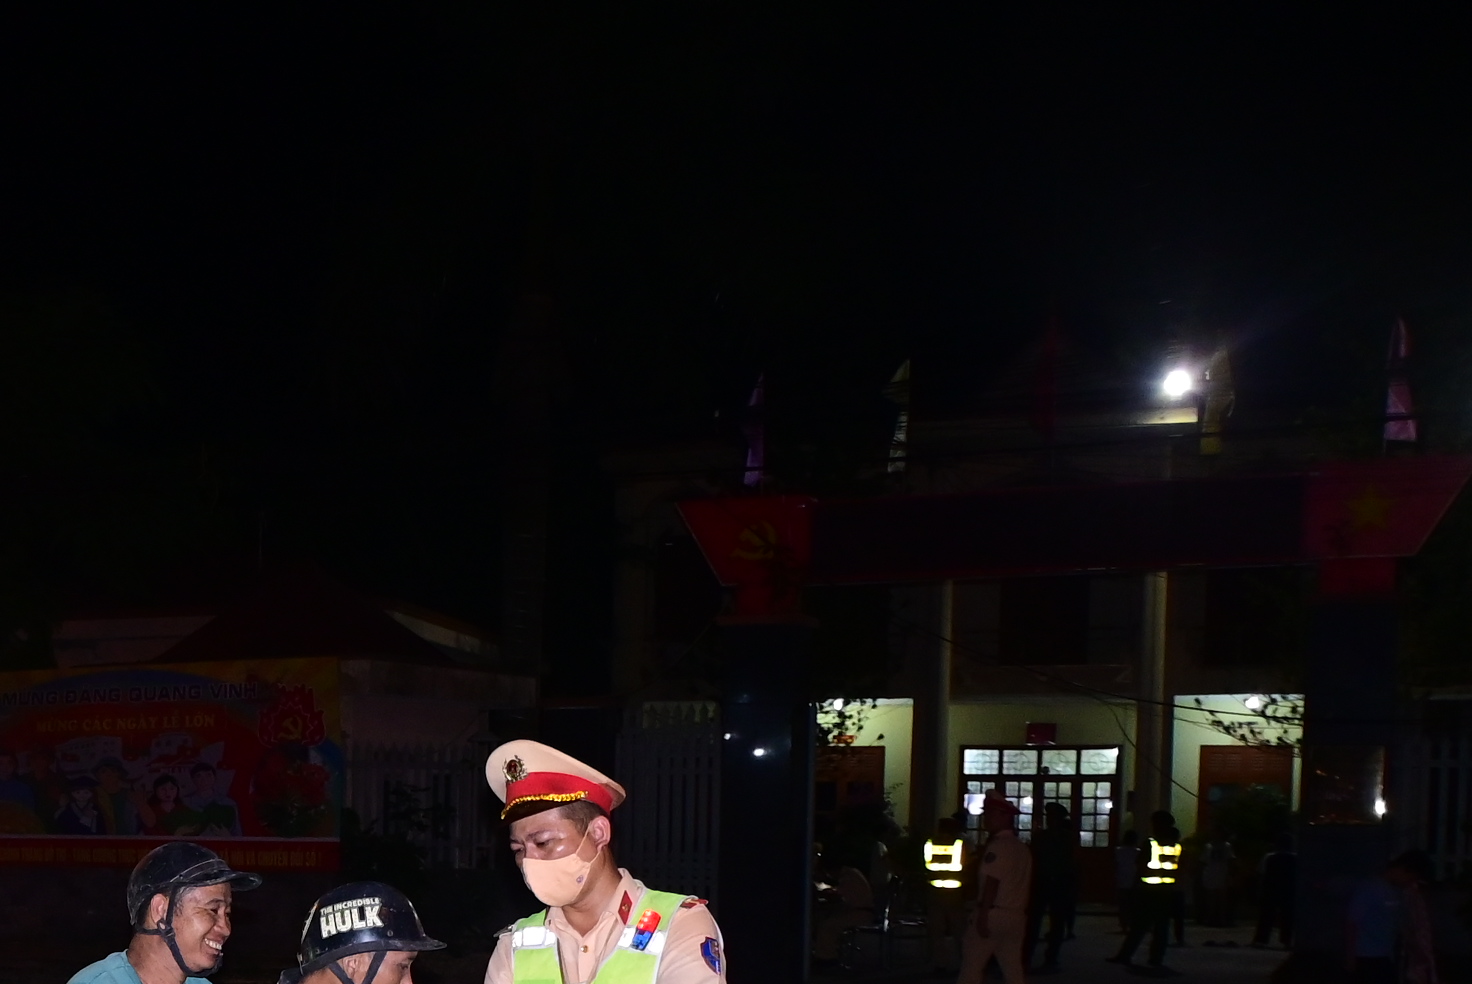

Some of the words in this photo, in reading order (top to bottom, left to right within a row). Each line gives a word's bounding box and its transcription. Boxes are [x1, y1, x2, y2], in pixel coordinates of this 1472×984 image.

[129, 684, 202, 703] QUANG
[209, 682, 257, 699] VINH
[82, 714, 112, 732] CÁC
[116, 712, 159, 730] NGÀY
[333, 896, 382, 911] INCREDIBLE
[320, 904, 385, 939] HULK
